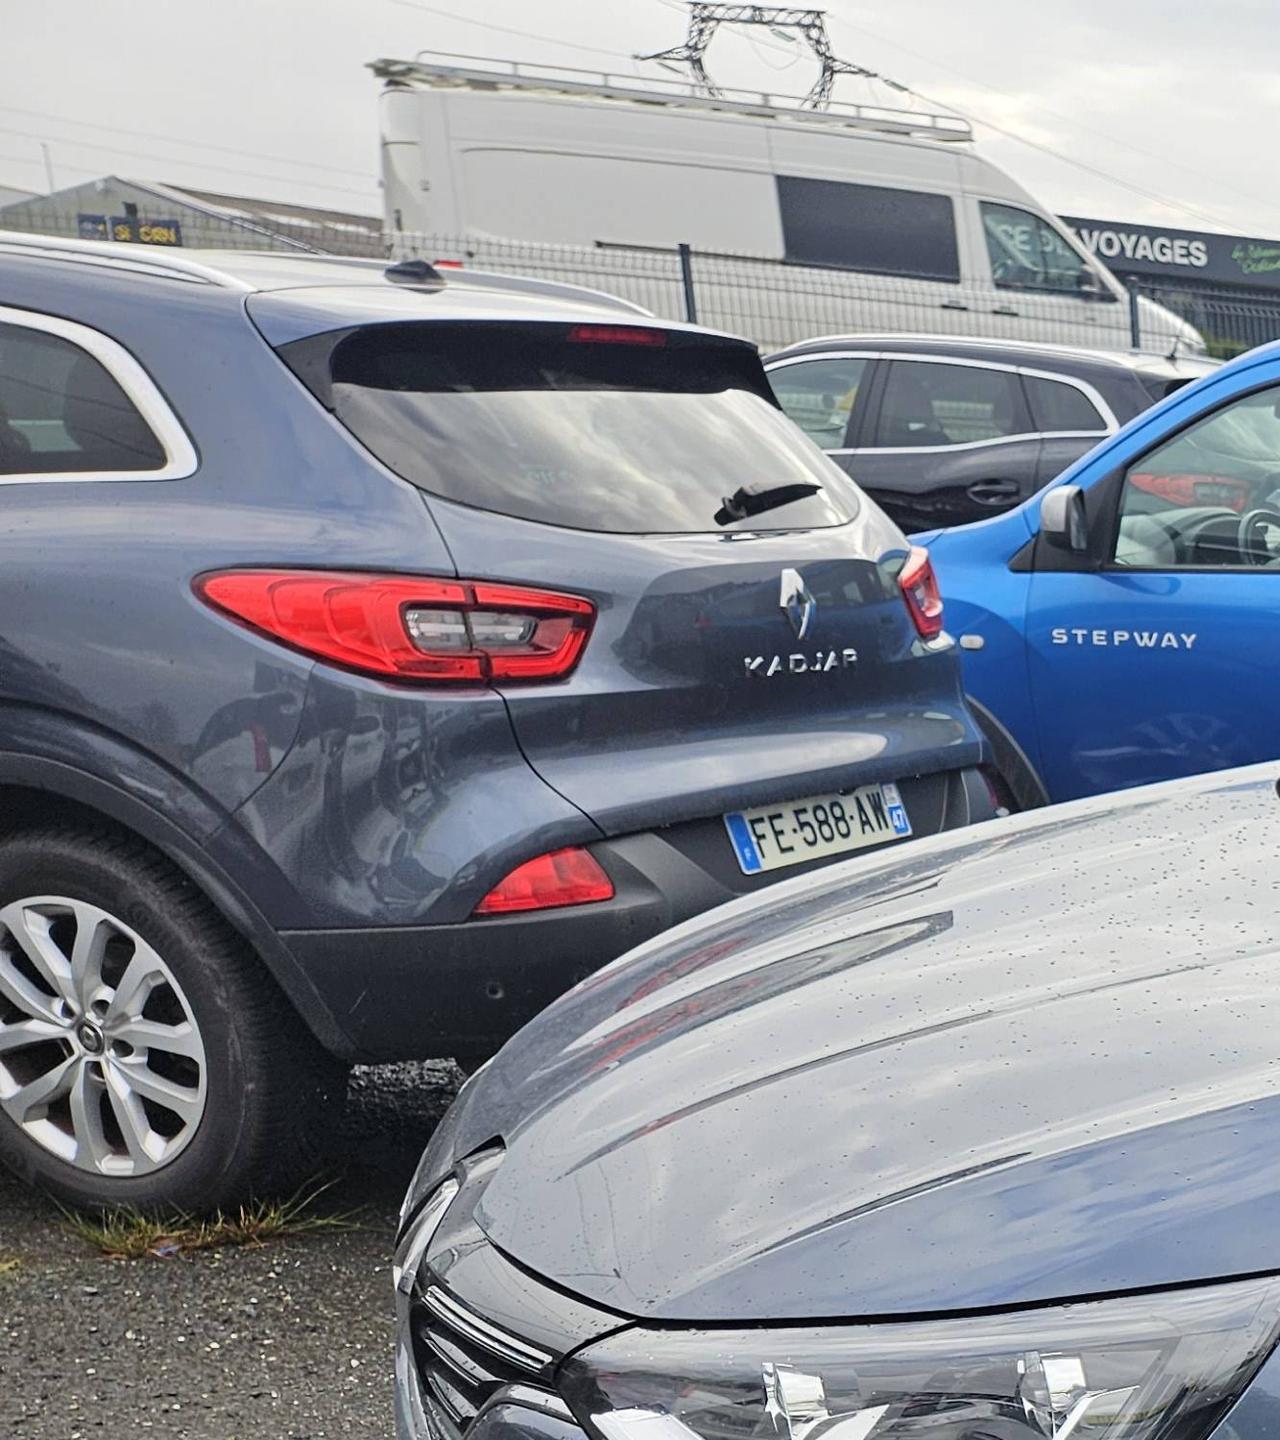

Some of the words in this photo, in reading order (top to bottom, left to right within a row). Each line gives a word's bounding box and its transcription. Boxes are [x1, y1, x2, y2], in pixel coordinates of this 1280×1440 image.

[1079, 228, 1208, 267] VOYAGES
[1051, 628, 1197, 649] STEPWAY
[744, 648, 857, 677] KADJAR
[892, 809, 905, 829] 47
